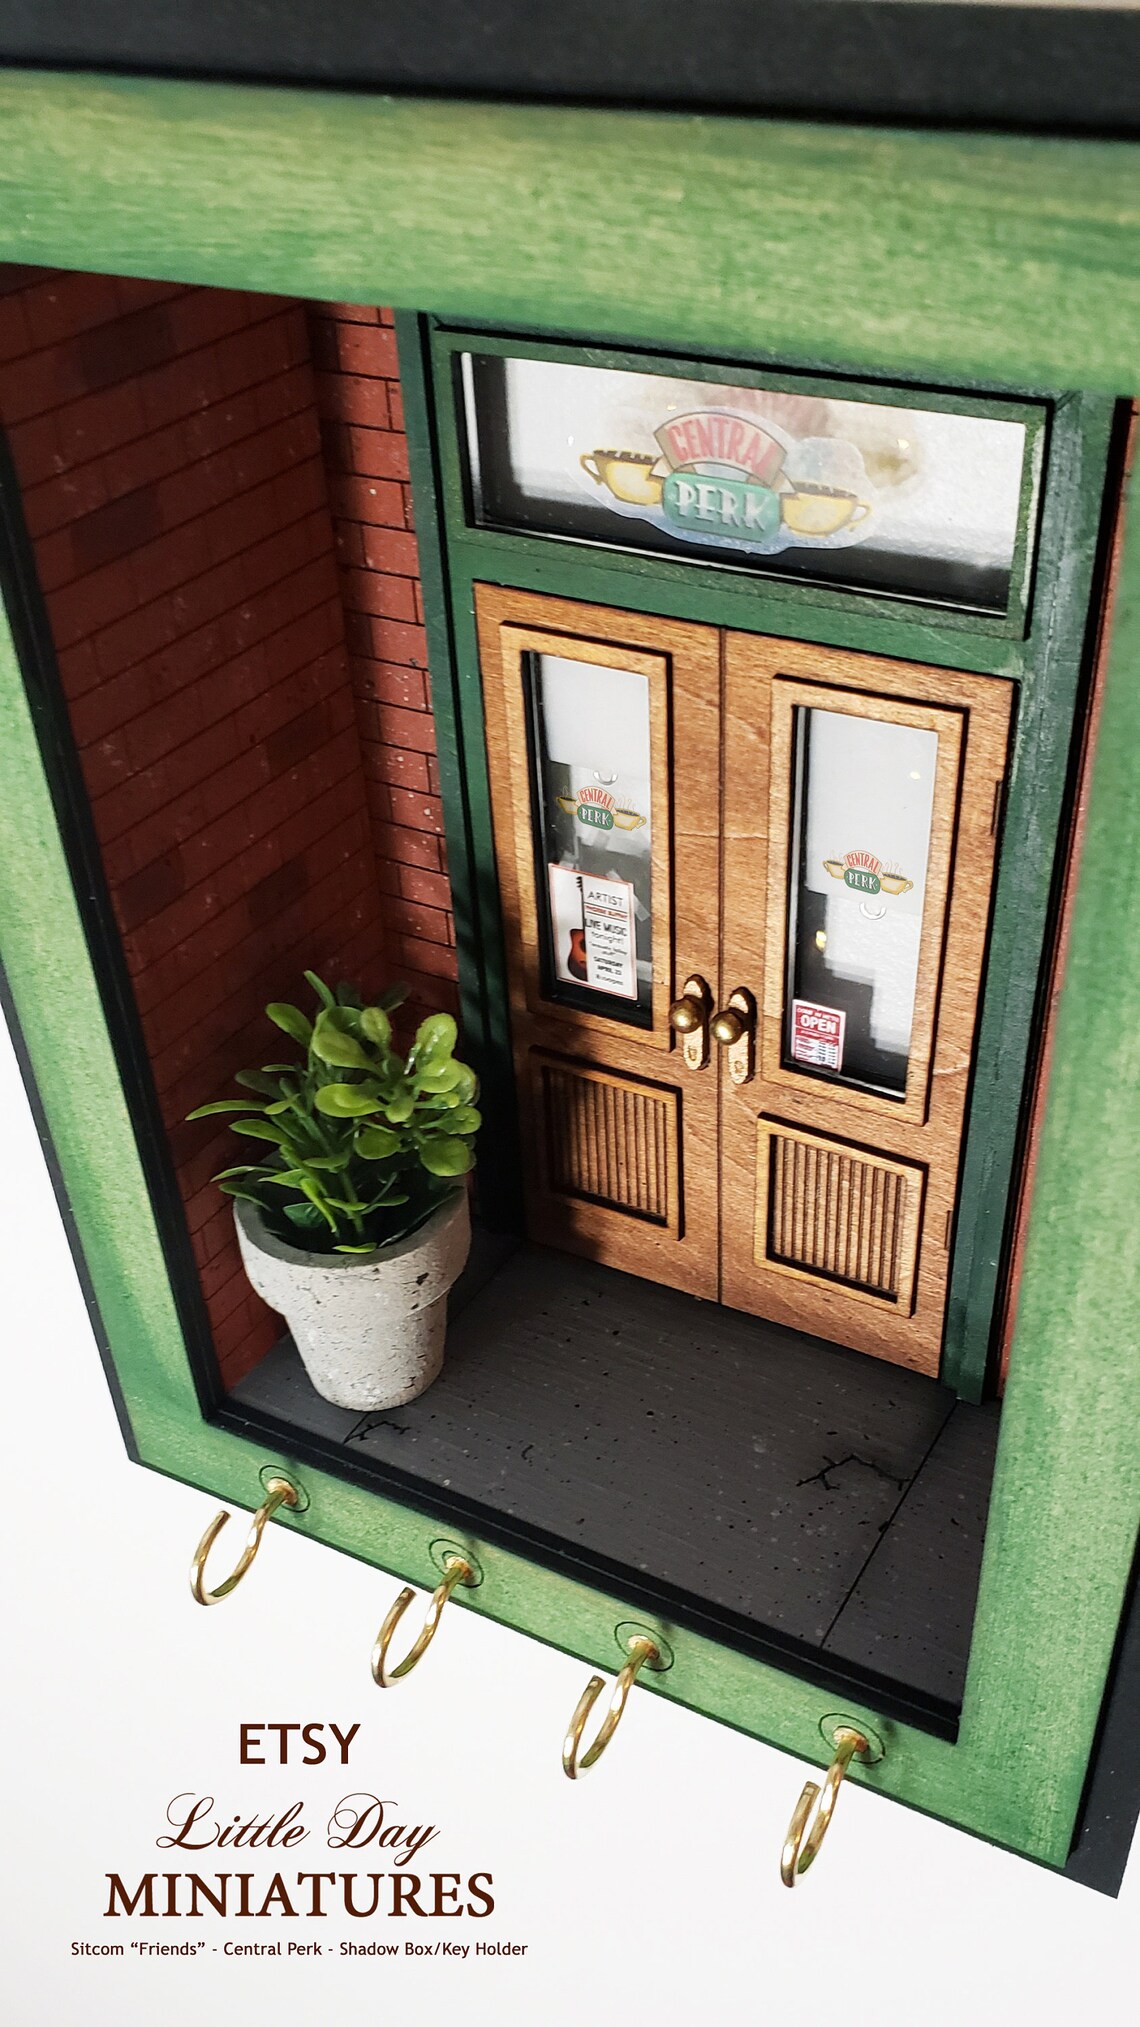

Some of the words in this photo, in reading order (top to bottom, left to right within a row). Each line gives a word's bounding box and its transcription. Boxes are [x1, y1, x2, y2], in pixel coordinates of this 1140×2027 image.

[667, 416, 779, 477] CENTRAL
[675, 479, 769, 532] PERK
[579, 788, 613, 809] CENTRAL
[581, 807, 610, 827] PERK
[846, 852, 880, 874] CENTRAL
[848, 871, 877, 891] PERK
[587, 891, 623, 907] ARTIST
[800, 1014, 837, 1034] OPEN
